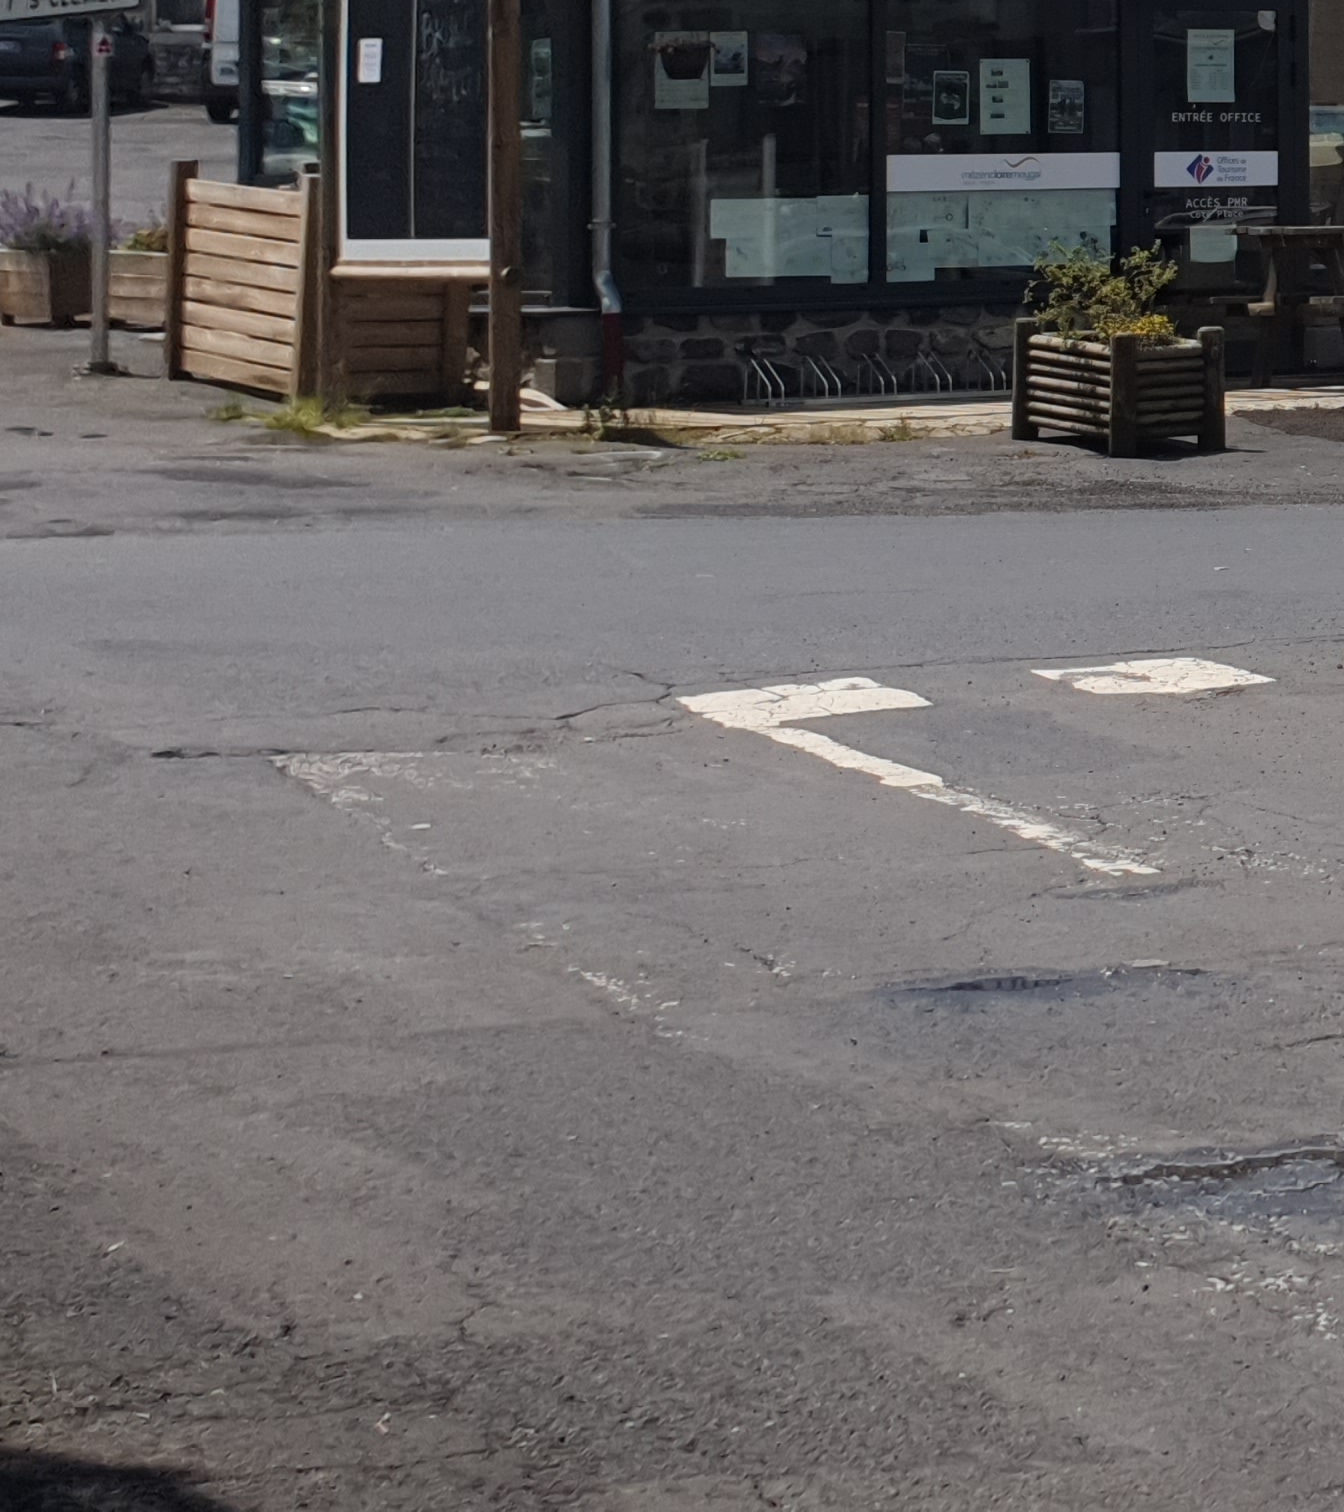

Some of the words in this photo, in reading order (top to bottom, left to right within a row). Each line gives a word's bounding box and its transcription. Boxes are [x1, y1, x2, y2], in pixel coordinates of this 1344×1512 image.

[1171, 110, 1213, 123] ENTRÉE
[1220, 112, 1261, 123] OFFICE
[1185, 195, 1220, 208] ACCÈS
[1227, 197, 1248, 207] PMR
[1217, 209, 1244, 218] Place
